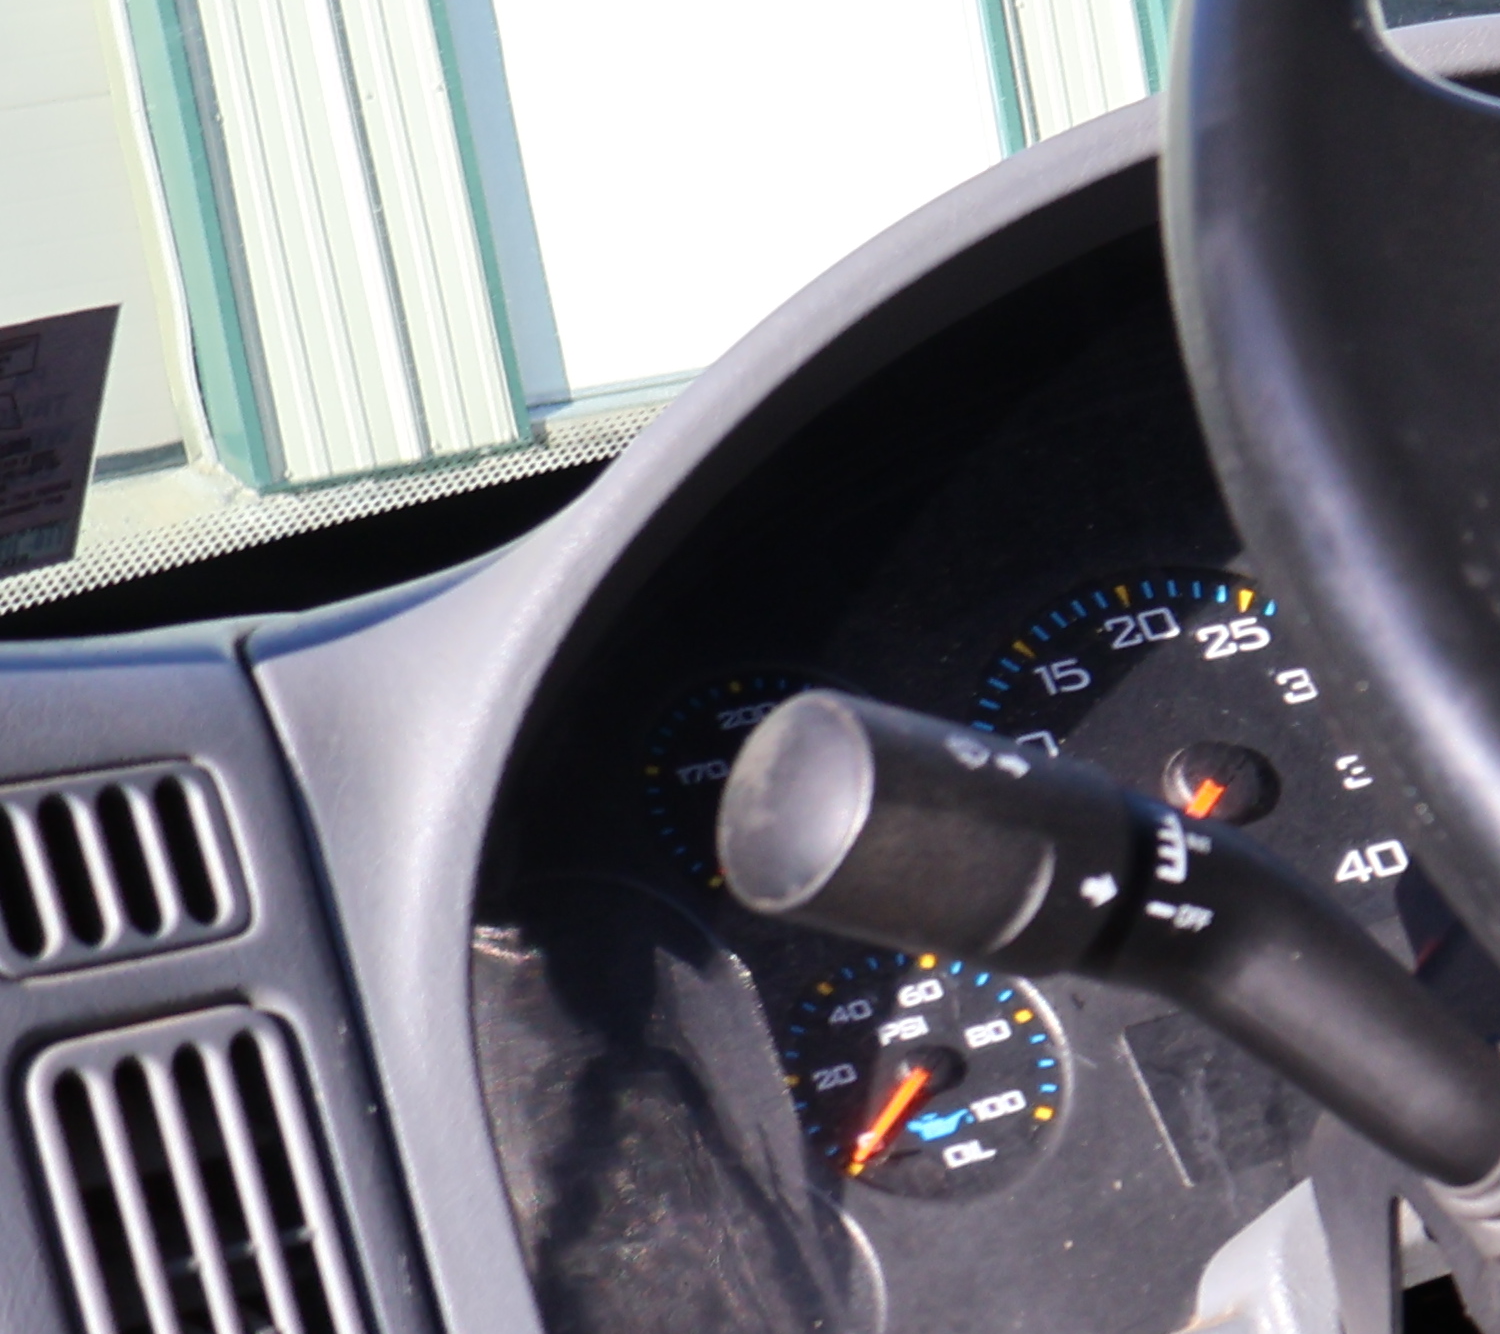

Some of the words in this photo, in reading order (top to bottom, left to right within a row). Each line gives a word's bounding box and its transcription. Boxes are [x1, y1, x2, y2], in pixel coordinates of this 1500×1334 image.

[1104, 606, 1181, 650] 20
[1196, 617, 1271, 661] 25
[1034, 657, 1091, 696] 15
[1334, 839, 1409, 883] 40
[897, 978, 945, 1008] 60
[828, 999, 873, 1025] 40
[877, 1015, 930, 1047] PSI
[963, 1018, 1012, 1049] 80
[811, 1063, 858, 1092] 20
[969, 1089, 1027, 1122] 100
[942, 1139, 997, 1169] OIL
